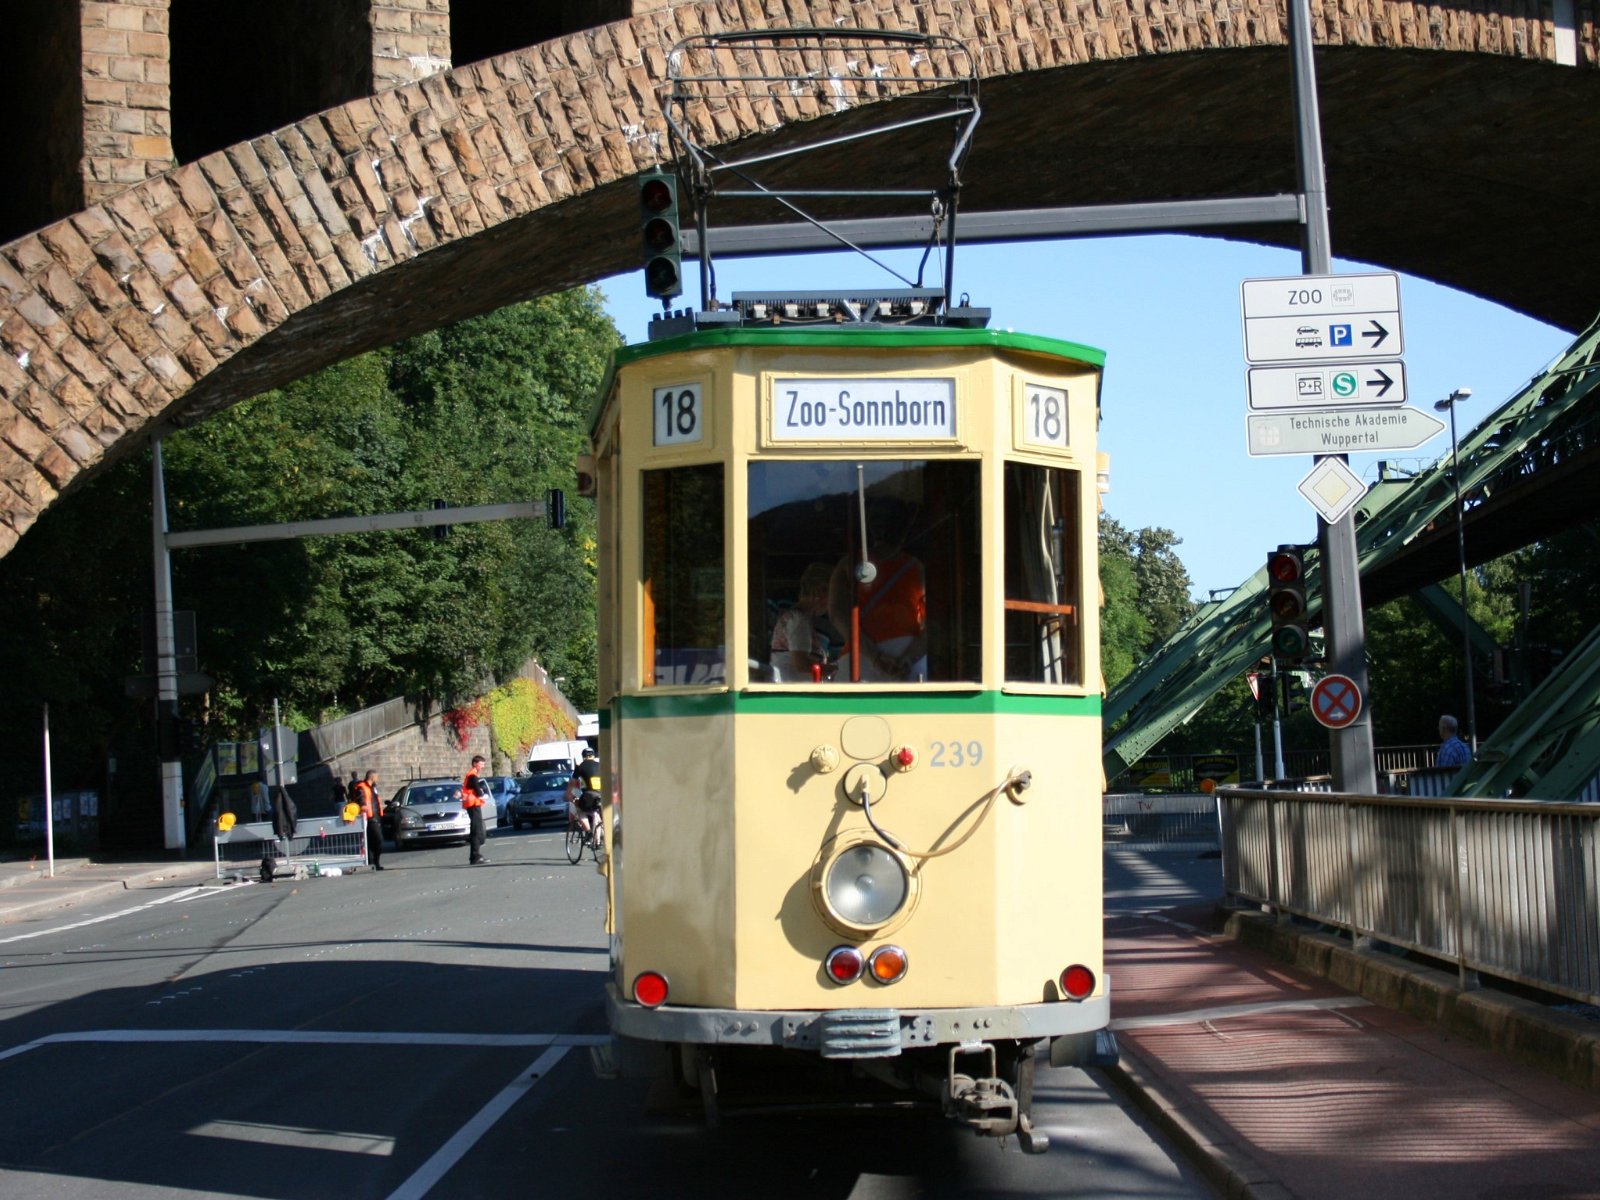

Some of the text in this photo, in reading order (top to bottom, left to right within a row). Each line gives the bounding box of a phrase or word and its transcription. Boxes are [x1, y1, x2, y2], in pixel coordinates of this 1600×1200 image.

[1287, 289, 1322, 305] ZOO
[1333, 326, 1348, 345] P
[1298, 380, 1323, 393] P+R
[661, 389, 697, 438] 18
[786, 390, 946, 428] Zoo-Sonnborn
[1030, 393, 1063, 441] 18
[1290, 413, 1408, 430] Technische Akademie
[1321, 431, 1379, 447] Wuppertal
[929, 740, 984, 768] 239
